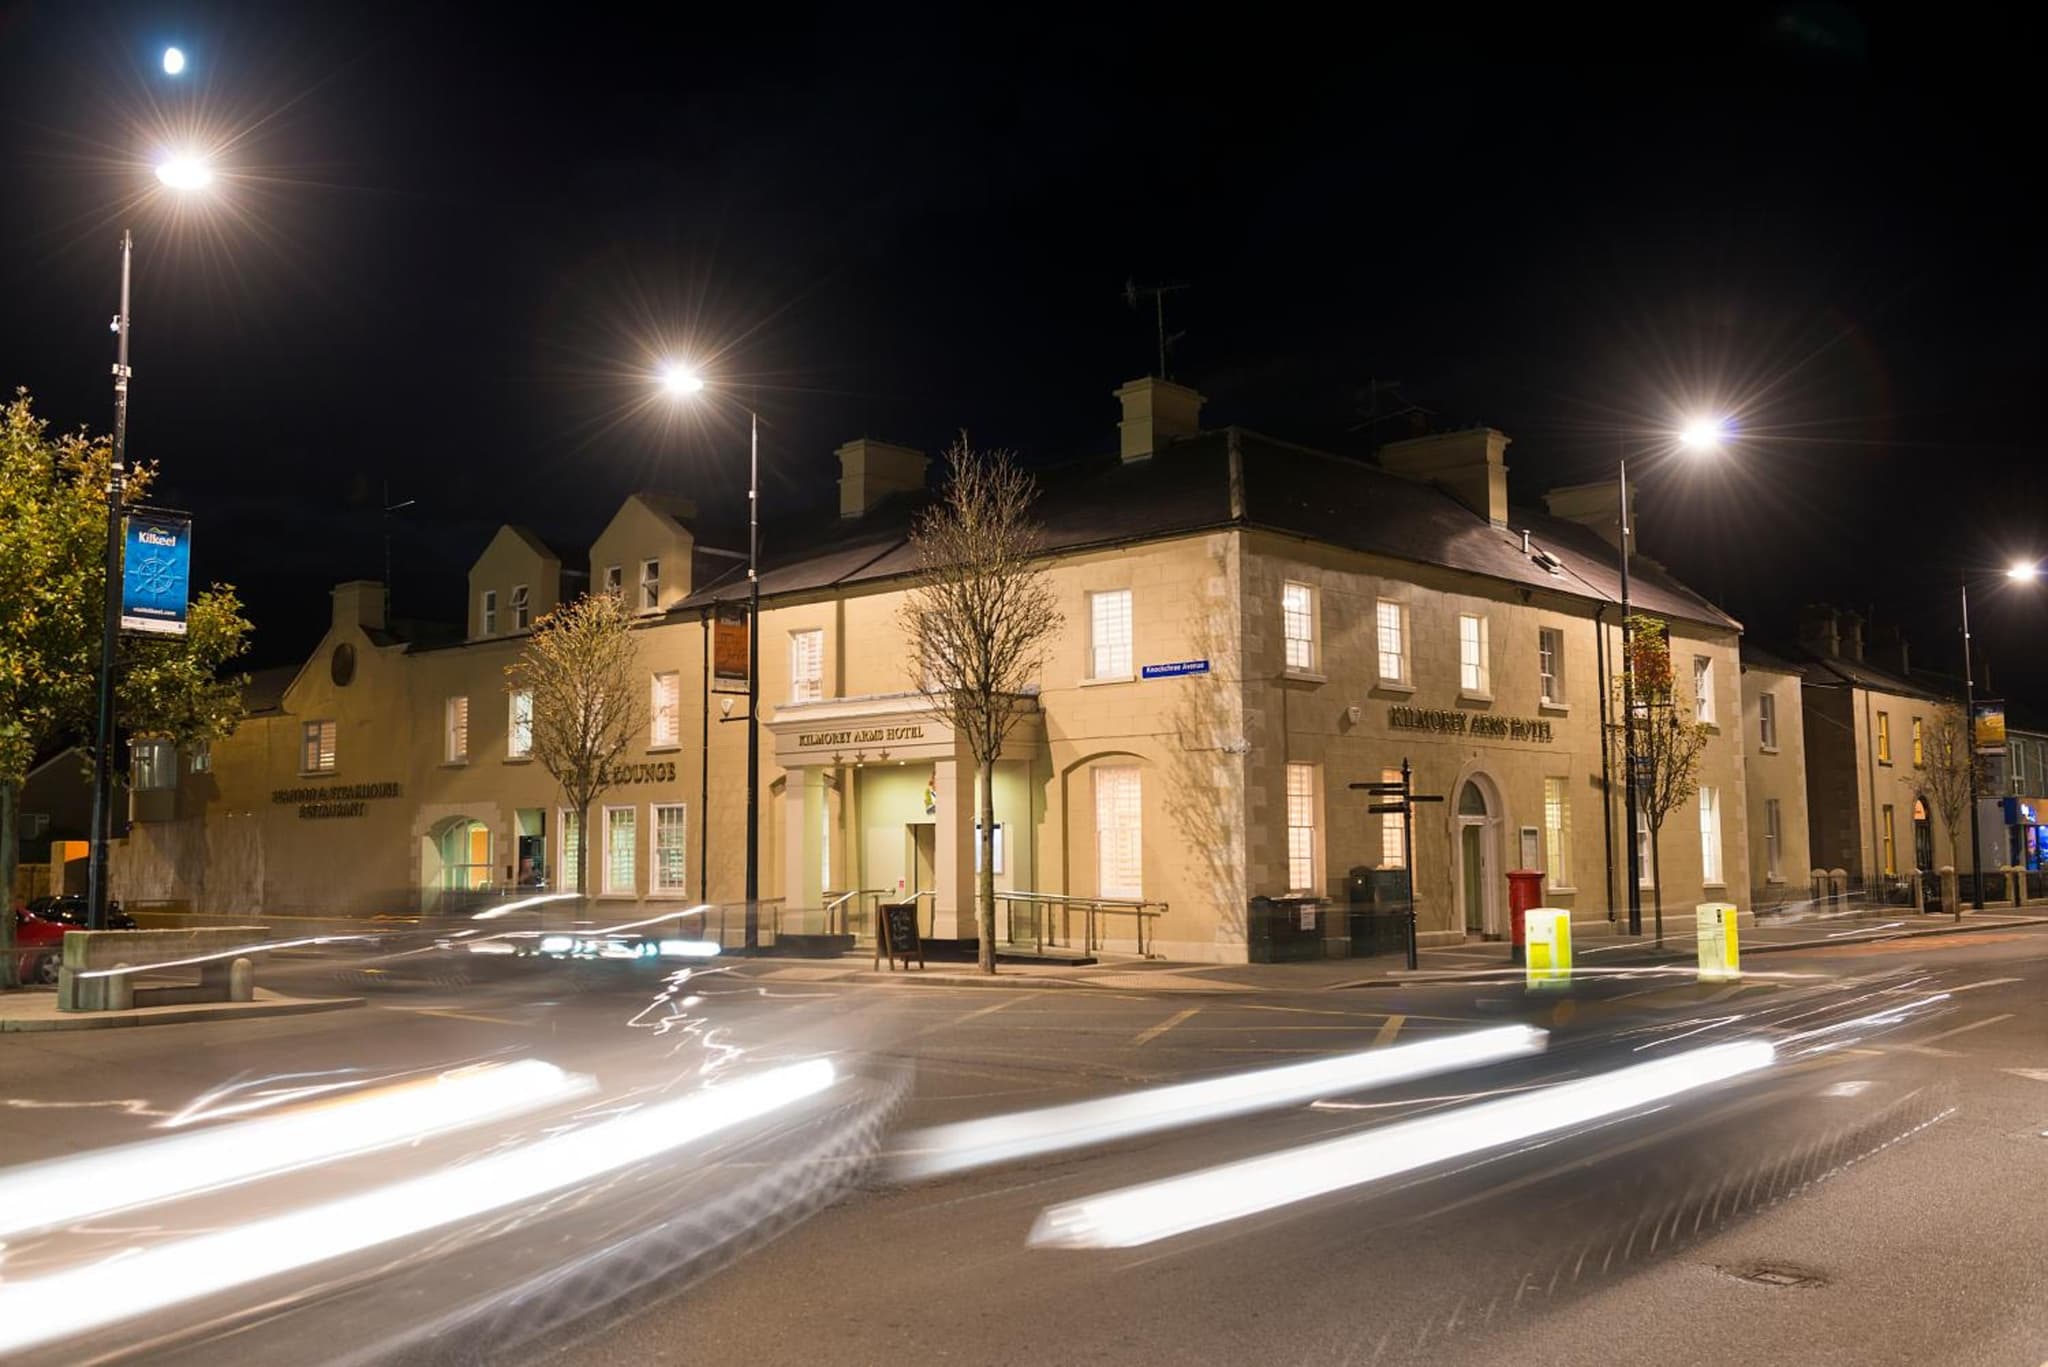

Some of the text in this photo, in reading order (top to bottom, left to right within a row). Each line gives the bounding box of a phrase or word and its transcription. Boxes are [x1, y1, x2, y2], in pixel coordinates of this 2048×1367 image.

[138, 531, 176, 547] Kilkeel
[1182, 662, 1205, 671] Avenue
[1391, 706, 1554, 743] KILMOREY ARMS HOTEL
[799, 726, 924, 746] KILMOREY ARMS HOTEL
[613, 762, 676, 785] LOUNGE
